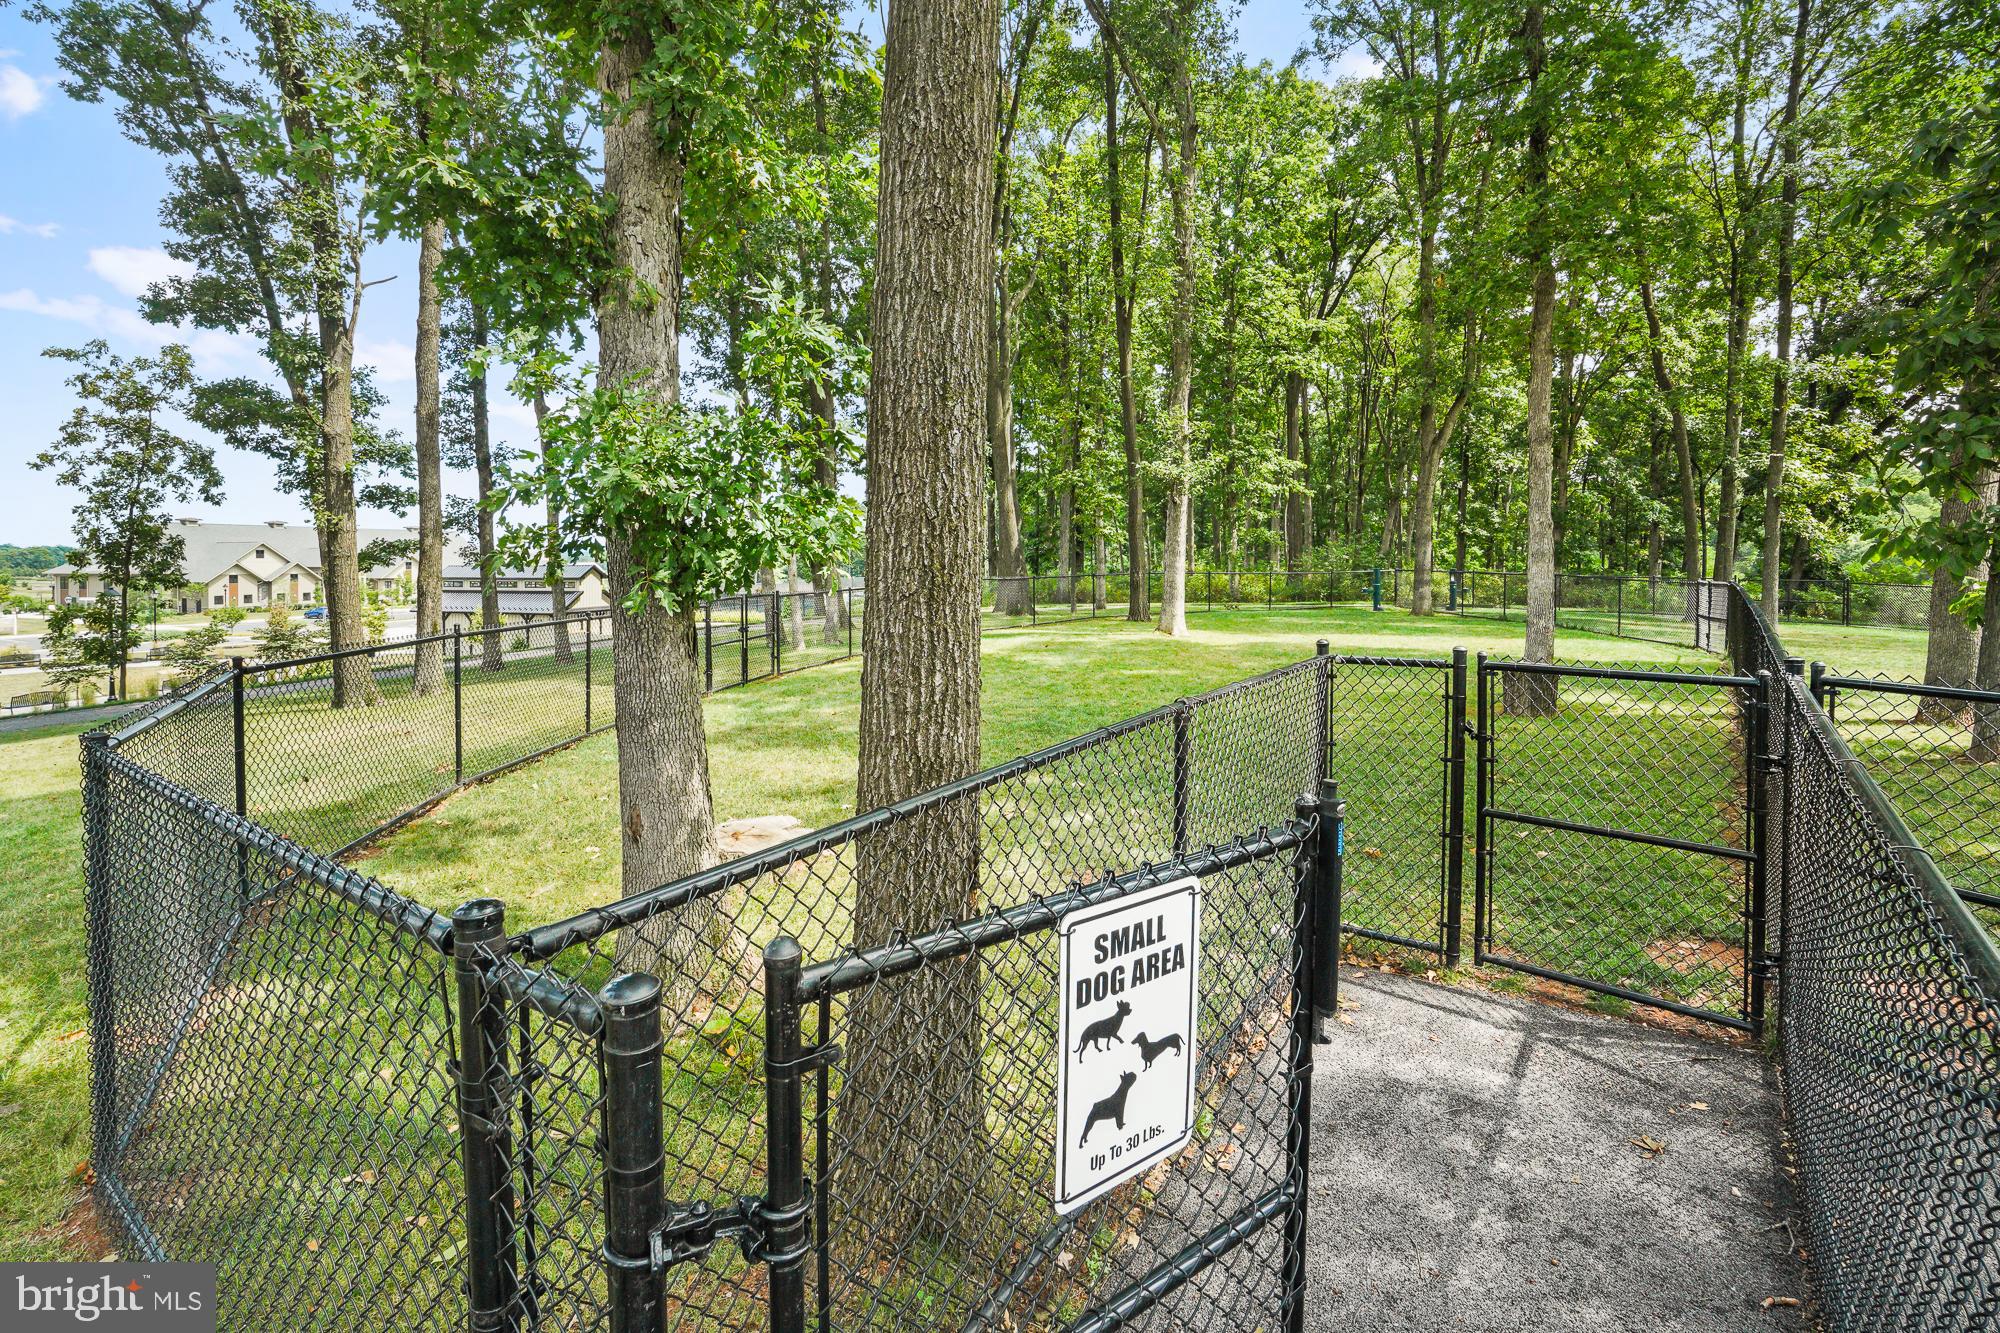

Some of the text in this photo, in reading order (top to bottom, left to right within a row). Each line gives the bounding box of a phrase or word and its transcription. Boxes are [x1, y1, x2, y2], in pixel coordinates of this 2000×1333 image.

[1094, 914, 1167, 964] SMALL
[1076, 942, 1185, 1010] DOG AREA
[1090, 1124, 1165, 1171] Up To 30 Lbs.
